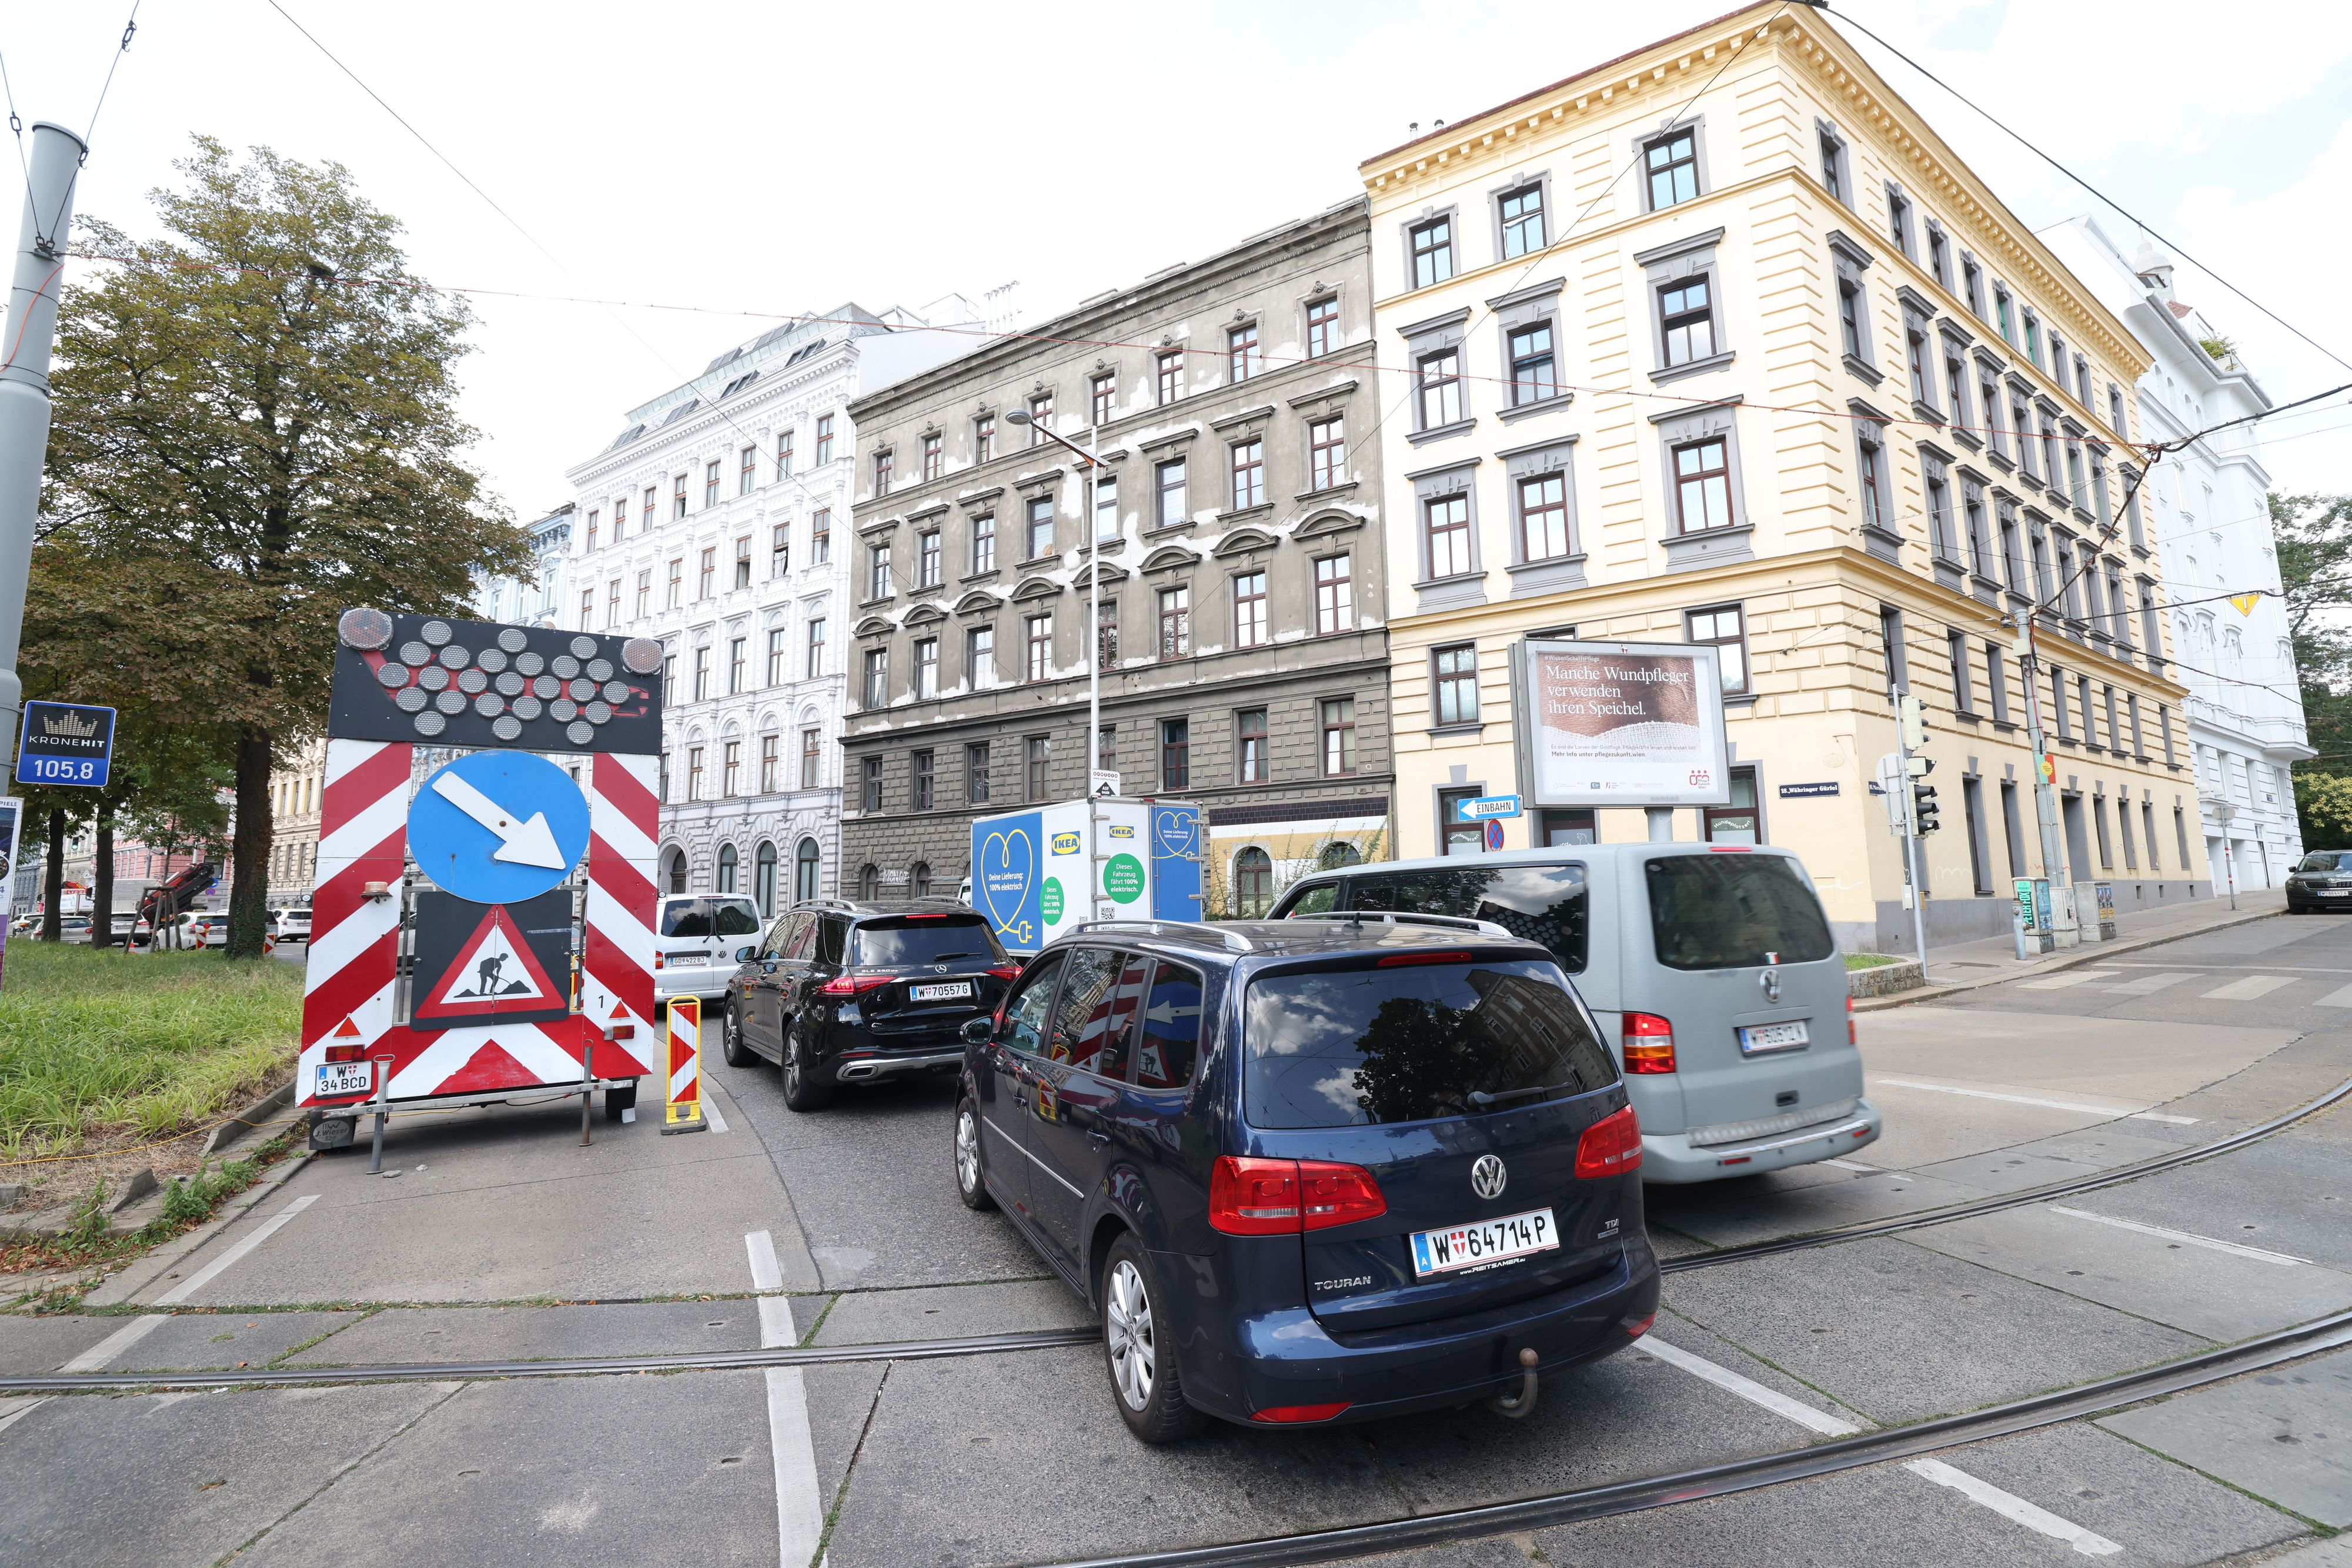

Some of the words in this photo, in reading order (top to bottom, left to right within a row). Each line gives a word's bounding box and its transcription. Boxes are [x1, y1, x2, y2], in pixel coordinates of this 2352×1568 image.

[1546, 665, 1600, 680] Manche
[1603, 667, 1689, 684] Wundpfleger
[1547, 683, 1621, 697] verwenden
[1549, 700, 1585, 714] ihren
[1589, 701, 1646, 717] Speichel.
[29, 735, 105, 748] KRONEHIT
[34, 760, 93, 781] 105,8
[1476, 801, 1511, 814] EINBAHN
[1054, 838, 1078, 849] IKEA
[1001, 872, 1024, 881] Lieferung:
[1001, 882, 1023, 891] elektrisch
[918, 987, 926, 998] W
[932, 985, 960, 997] 70557
[962, 984, 968, 994] G
[337, 1066, 347, 1078] W
[321, 1079, 338, 1092] 34
[341, 1076, 366, 1090] BCD
[1605, 1218, 1619, 1229] TDI
[1432, 1234, 1451, 1264] W
[1467, 1219, 1532, 1257] 64714
[1534, 1215, 1545, 1243] P
[1421, 1257, 1429, 1267] A
[1459, 1258, 1526, 1275] www.REITSAMER.eu
[1314, 1275, 1371, 1291] TOURAN
